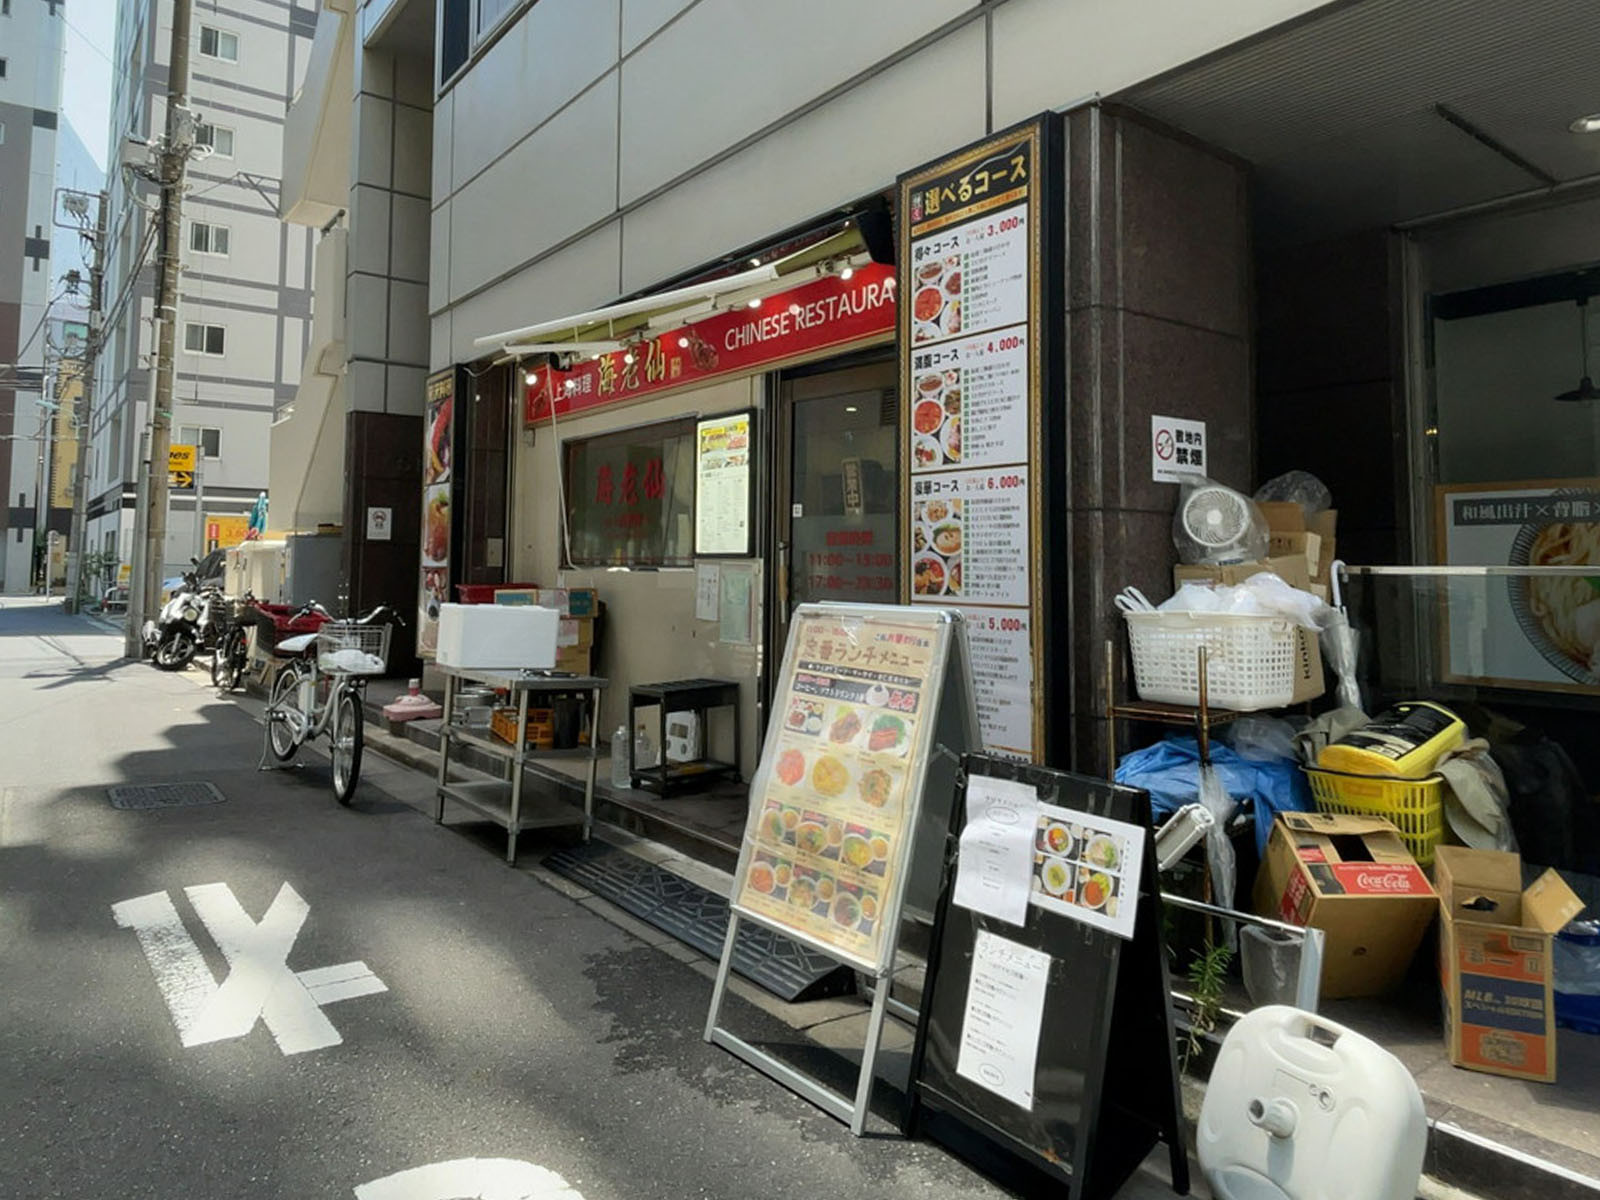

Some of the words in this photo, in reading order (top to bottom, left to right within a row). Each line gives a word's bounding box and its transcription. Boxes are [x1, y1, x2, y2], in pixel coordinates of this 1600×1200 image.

[925, 155, 1026, 215] 選べるコース
[724, 312, 790, 350] CHINESE
[795, 283, 895, 331] RESTAURA
[1176, 447, 1202, 466] 禁煙
